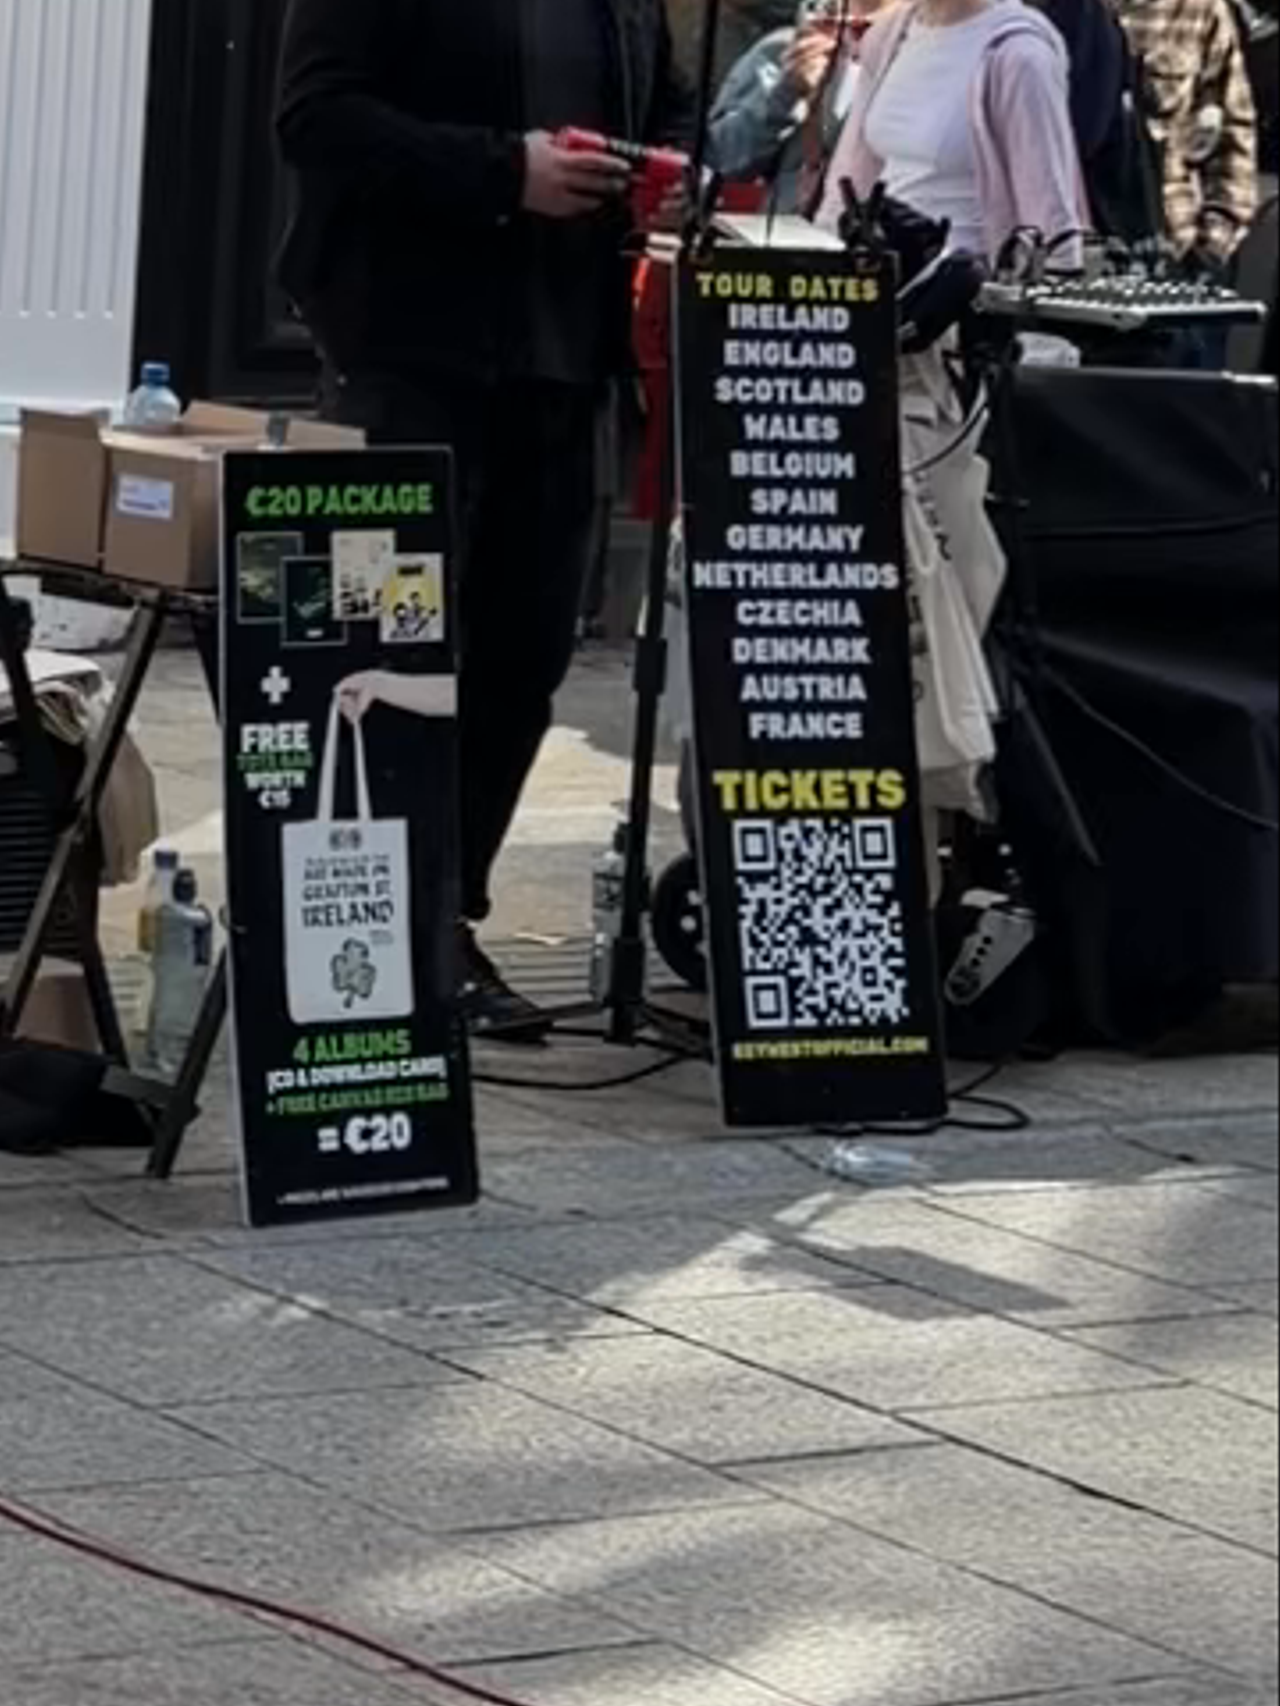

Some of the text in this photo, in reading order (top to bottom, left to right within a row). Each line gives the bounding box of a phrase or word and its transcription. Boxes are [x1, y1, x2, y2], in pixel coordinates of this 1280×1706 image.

[696, 272, 878, 301] TOUR DATES
[728, 302, 850, 331] IRELAND
[723, 339, 856, 369] ENGLAND
[714, 376, 866, 405] SCOTLAND
[743, 413, 841, 441] WALES
[729, 450, 856, 479] BELGIUM
[245, 483, 434, 517] €20 PACKAGE
[749, 487, 839, 516] SPAIN
[725, 524, 864, 553] GERMANY
[692, 560, 900, 590] NETHERLANDS
[736, 598, 863, 627] CZECHIA
[731, 635, 871, 664] DENMARK
[740, 673, 868, 702] AUSTRIA
[241, 721, 309, 753] FREE
[748, 711, 864, 740] FRANCE
[712, 768, 907, 811] TICKETS
[301, 898, 395, 928] IRELAND
[293, 1029, 412, 1063] 4 ALBUMS
[311, 1059, 398, 1086] DOWNLOAD
[343, 1111, 413, 1154] €20
